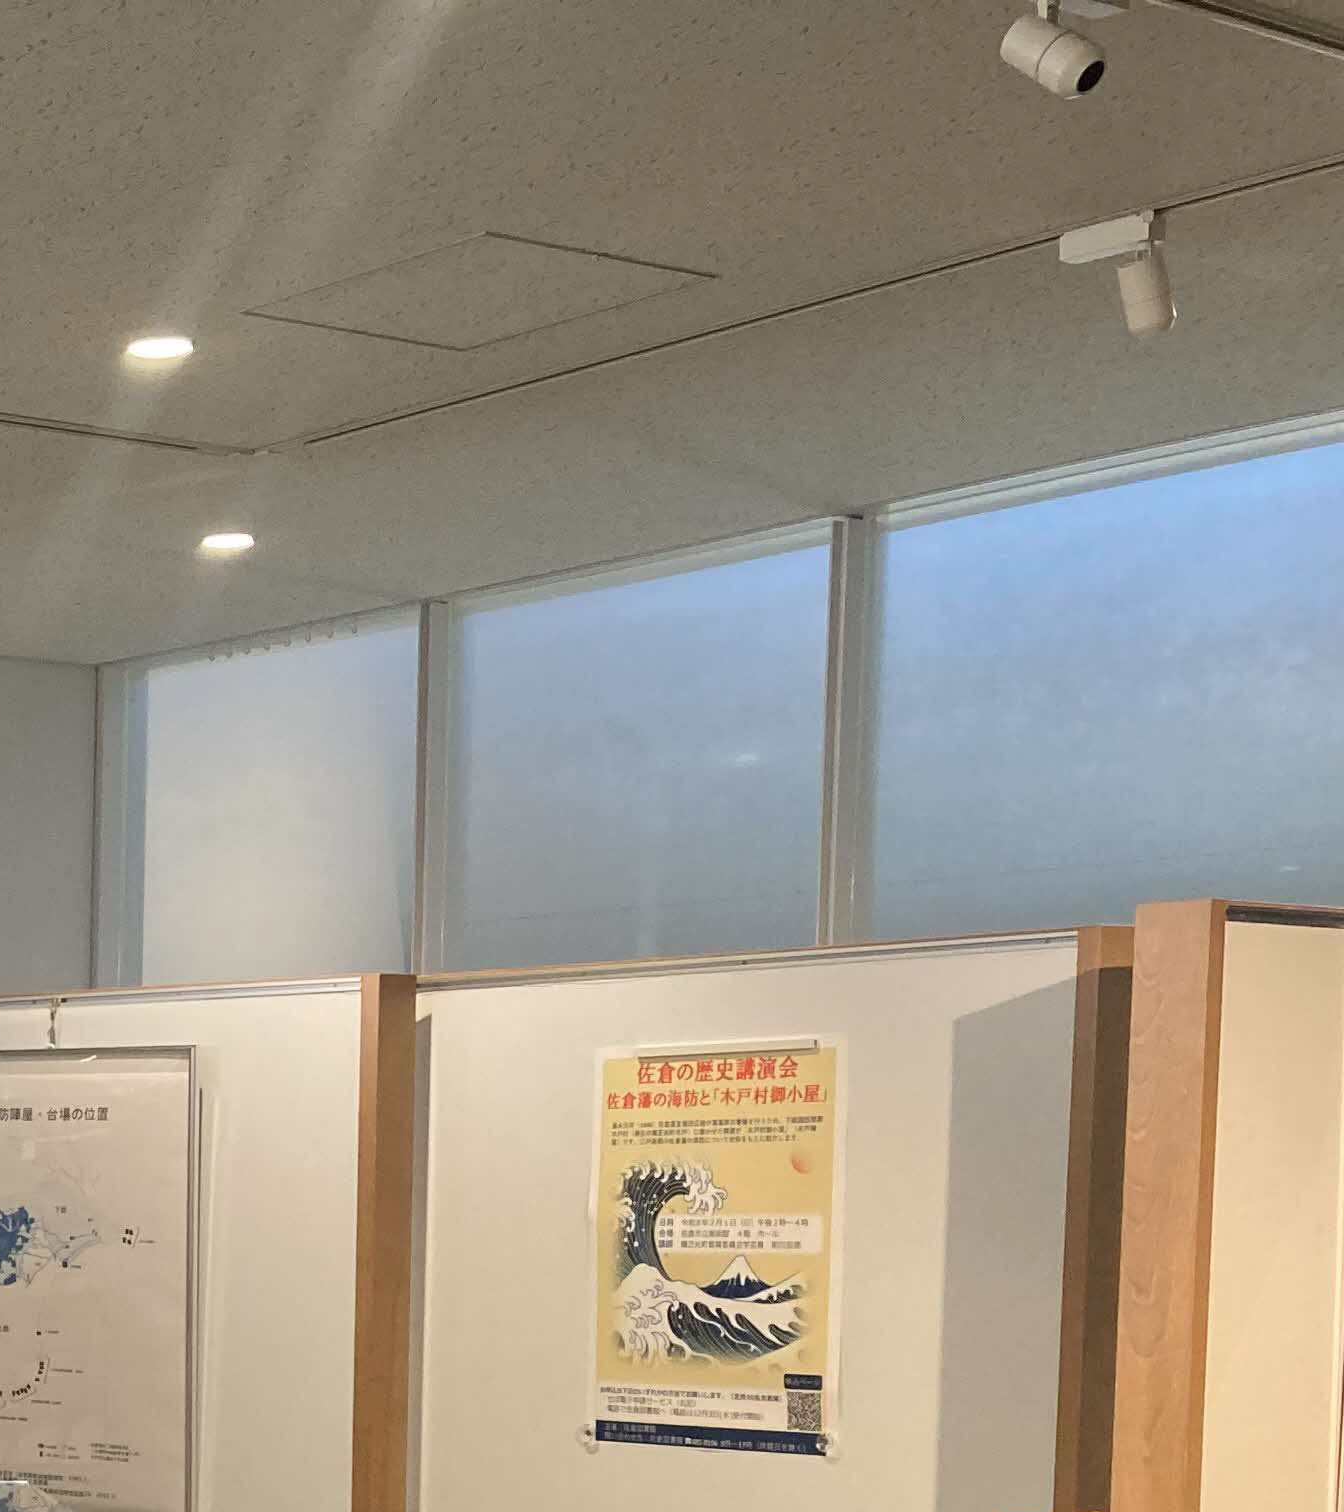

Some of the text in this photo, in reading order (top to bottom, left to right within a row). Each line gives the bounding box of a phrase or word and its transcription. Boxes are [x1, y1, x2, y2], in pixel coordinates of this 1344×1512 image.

[637, 1056, 799, 1084] 佐倉の歴史講演会
[607, 1084, 828, 1110] 佐倉藩の海防と「木戸村御小屋」
